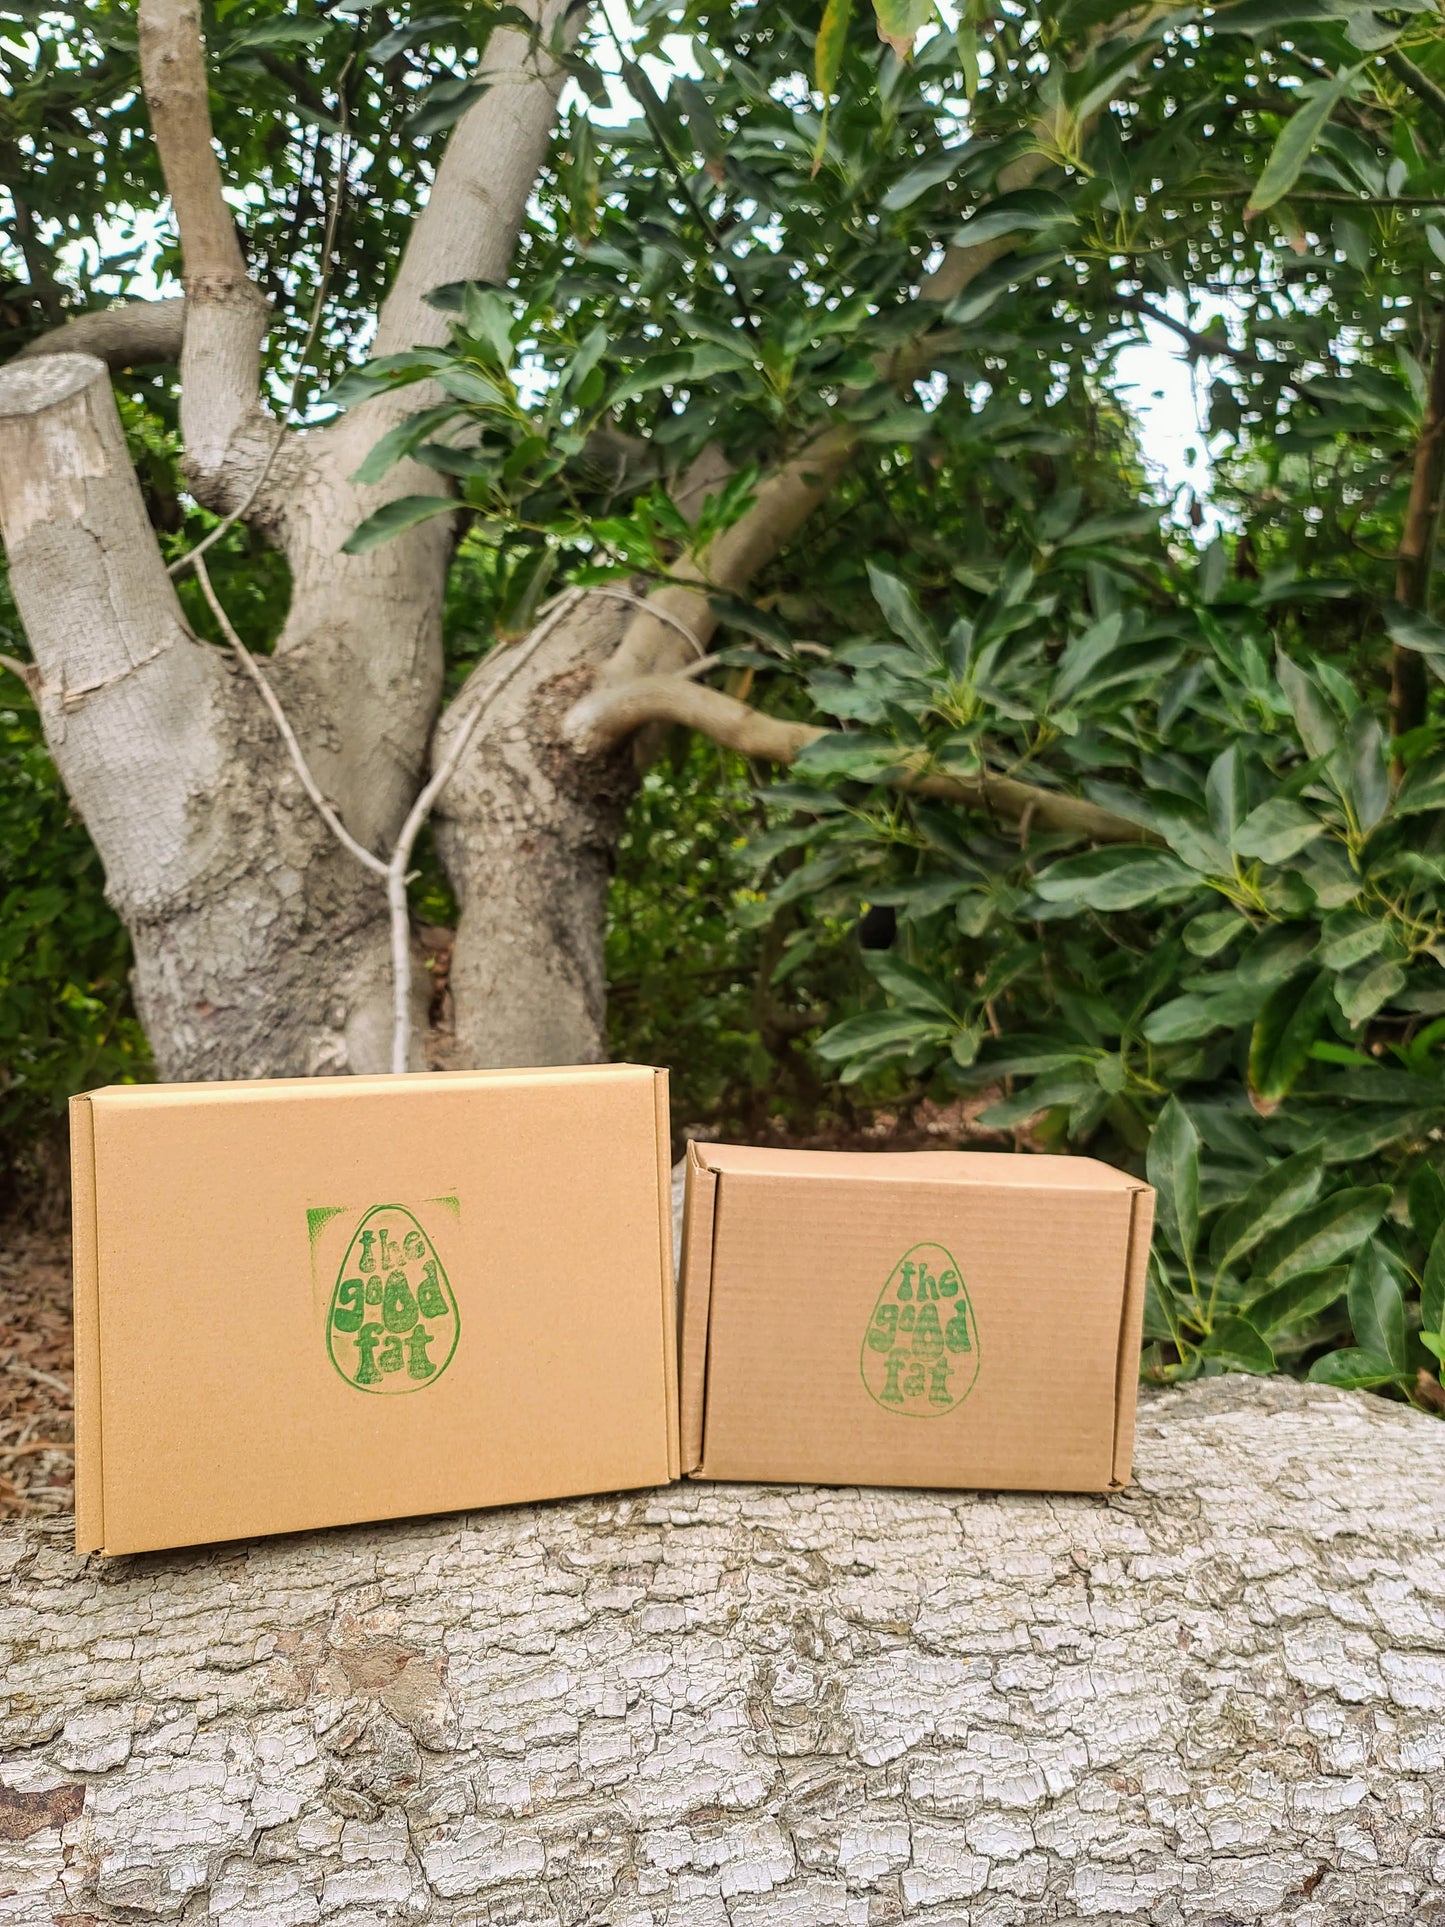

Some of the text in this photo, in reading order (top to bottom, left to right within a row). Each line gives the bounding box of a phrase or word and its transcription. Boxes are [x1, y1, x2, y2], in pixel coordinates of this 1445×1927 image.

[359, 1229, 425, 1273] the
[334, 1259, 449, 1333] good
[897, 1261, 958, 1302] the
[353, 1322, 437, 1384] fat
[868, 1299, 971, 1362] good
[879, 1348, 954, 1407] fat
